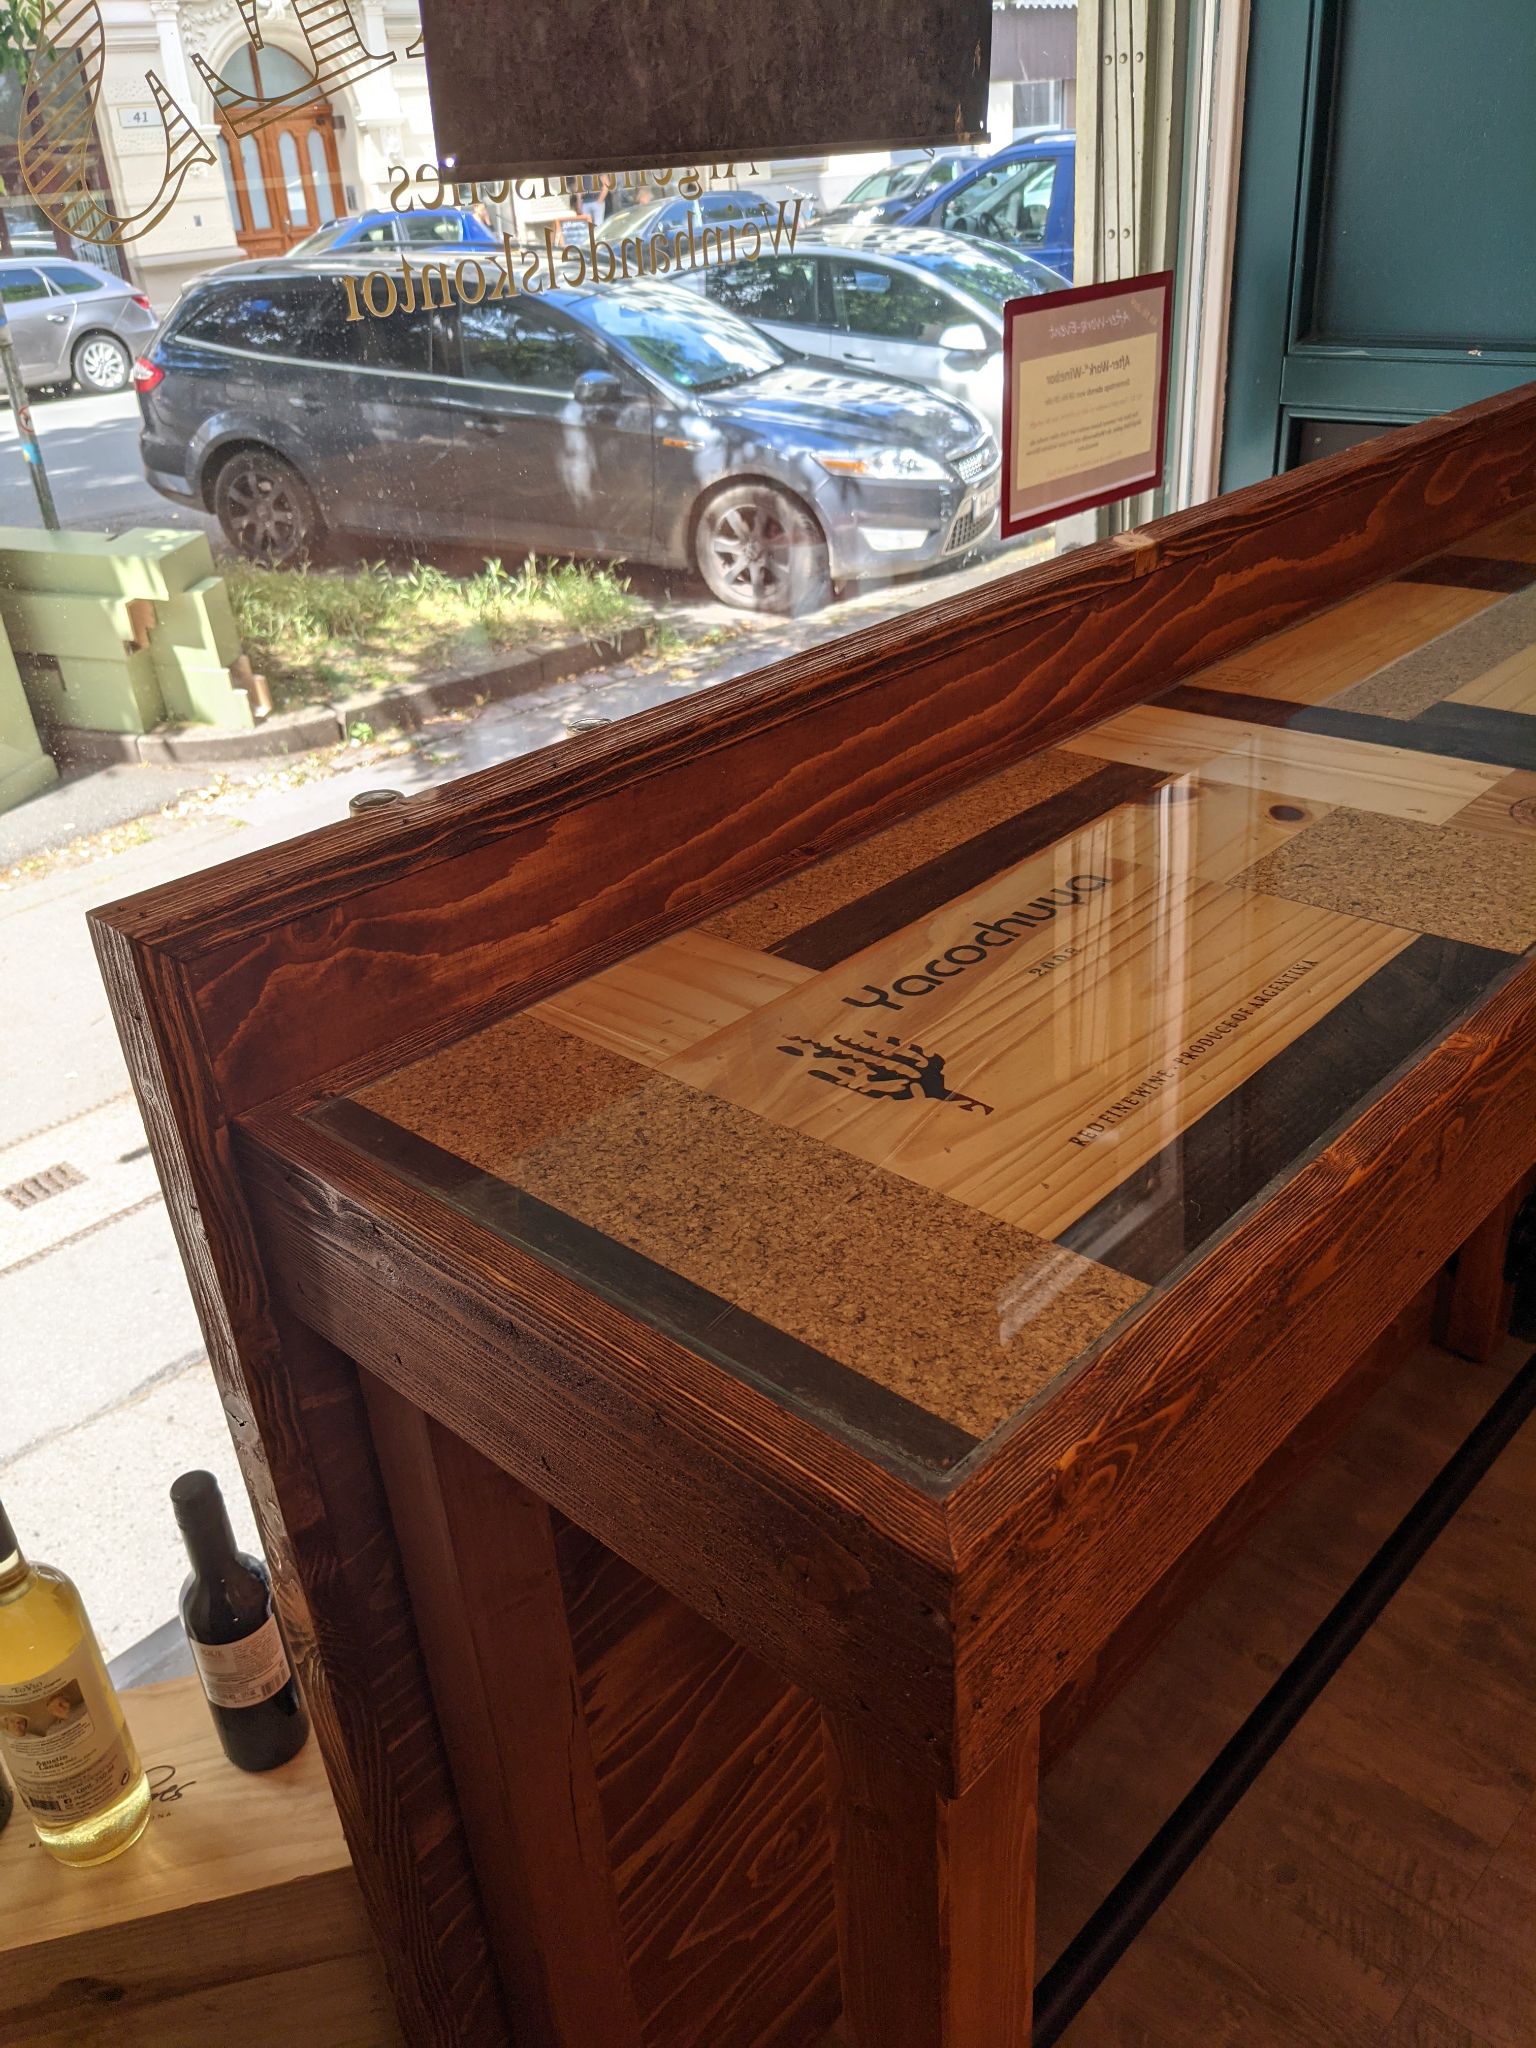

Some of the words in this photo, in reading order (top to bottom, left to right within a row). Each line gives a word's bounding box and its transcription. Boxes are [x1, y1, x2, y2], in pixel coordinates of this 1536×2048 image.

[133, 111, 149, 123] 41
[841, 874, 1113, 1011] Yacochuya
[1068, 1119, 1105, 1148] RED
[1100, 1096, 1140, 1125] FINE
[1131, 1069, 1175, 1102] WINE
[1176, 1019, 1240, 1066] PRODUCE
[1231, 1007, 1254, 1028] OF
[1248, 959, 1319, 1015] ARGENTINA
